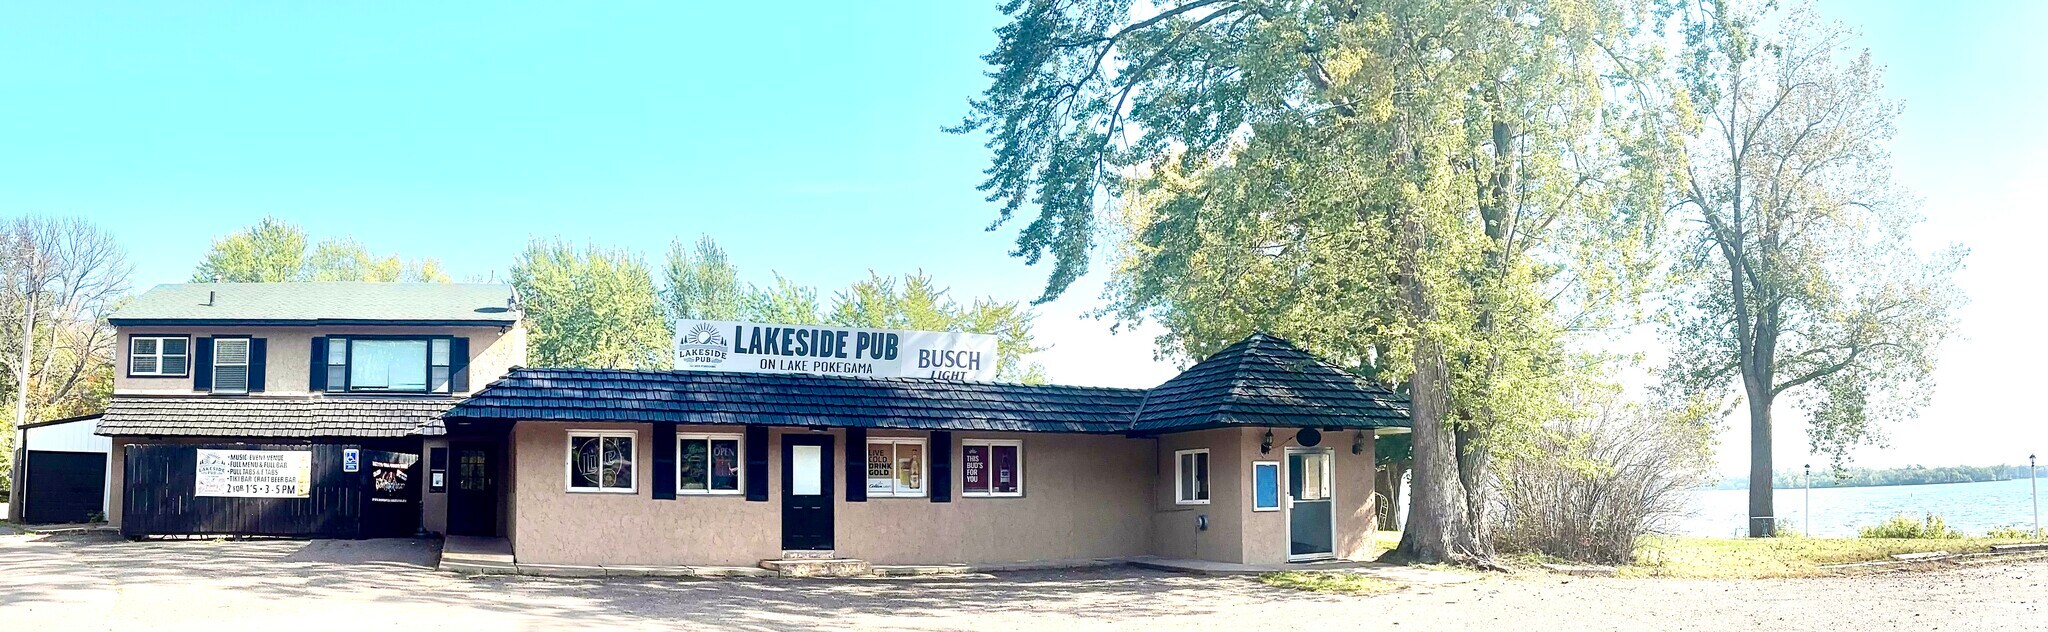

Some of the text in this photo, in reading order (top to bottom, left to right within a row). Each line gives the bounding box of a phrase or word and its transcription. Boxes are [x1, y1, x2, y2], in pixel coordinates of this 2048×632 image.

[734, 325, 899, 361] LAKESIDE PUB
[679, 349, 727, 359] LAKESIDE
[918, 349, 980, 371] BUSCH
[760, 358, 873, 374] ON LAKE POKEGAMA
[931, 370, 967, 381] LIGHT
[713, 447, 735, 457] OPEN
[227, 484, 231, 493] 2
[246, 484, 257, 493] 1'S
[265, 485, 269, 493] 3
[276, 485, 280, 494] 5
[282, 485, 295, 494] PM
